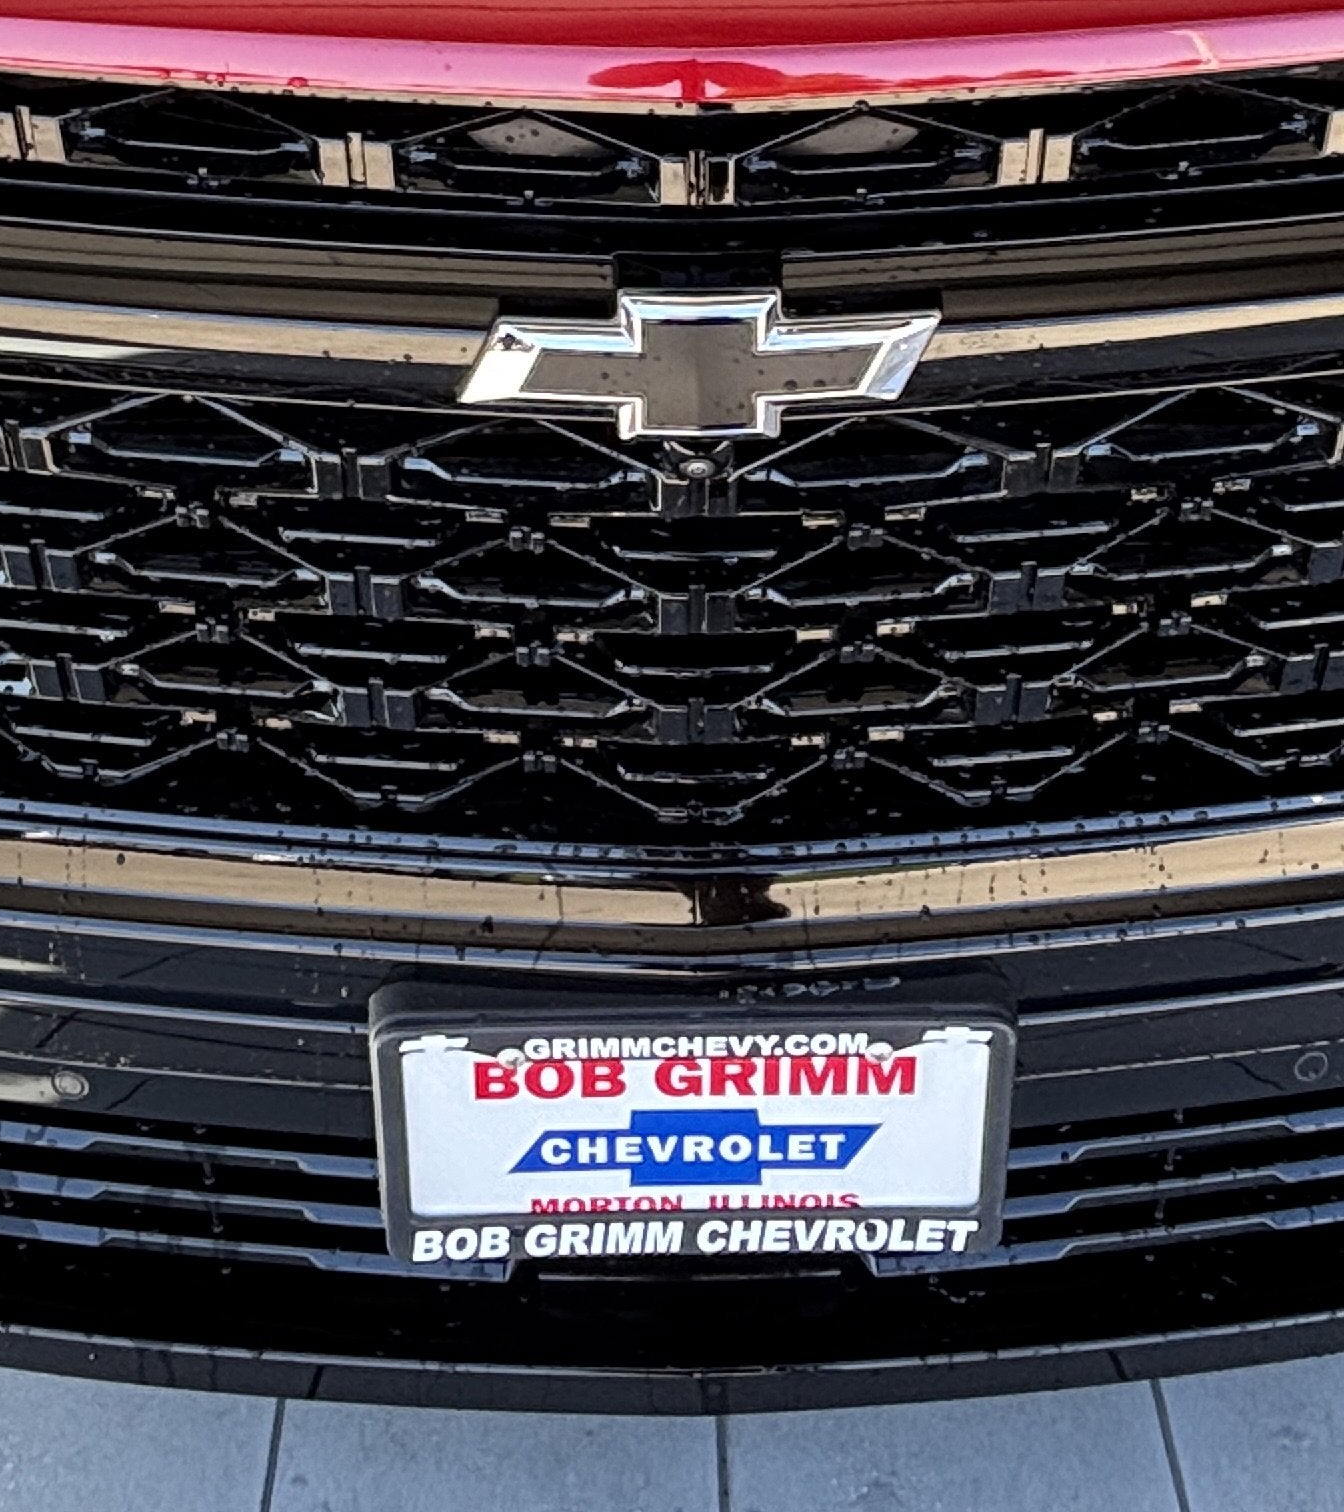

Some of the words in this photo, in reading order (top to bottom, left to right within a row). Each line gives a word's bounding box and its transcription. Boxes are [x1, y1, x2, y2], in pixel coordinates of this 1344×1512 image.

[523, 1033, 869, 1060] GRIMMCHEVY.COM
[473, 1058, 626, 1100] BOB
[654, 1055, 917, 1097] GRIMM
[540, 1133, 846, 1165] CHEVROLET
[530, 1194, 683, 1215] MORTON
[412, 1225, 511, 1263] BOB
[524, 1219, 685, 1259] GRIMM
[696, 1217, 979, 1253] CHEVROLET
